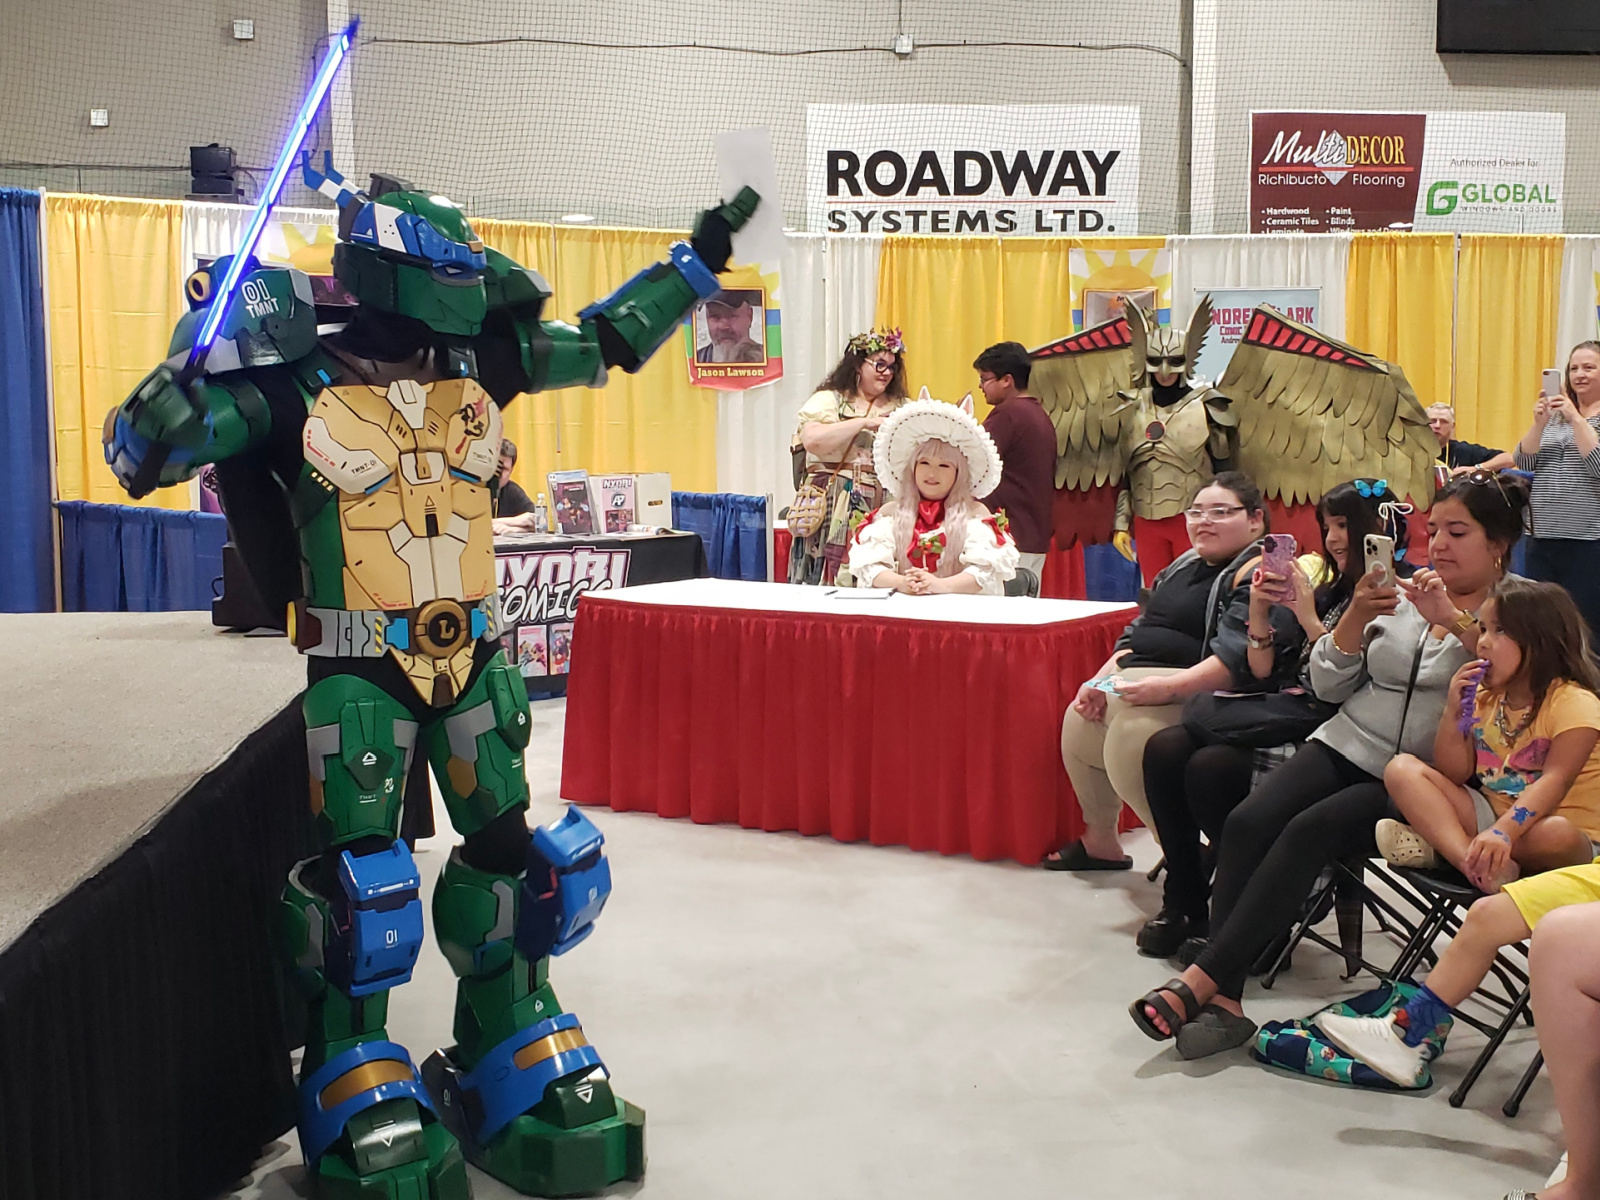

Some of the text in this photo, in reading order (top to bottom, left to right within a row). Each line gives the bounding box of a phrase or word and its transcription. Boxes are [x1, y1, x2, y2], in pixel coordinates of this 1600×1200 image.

[1261, 129, 1406, 165] Multi DECOR
[1451, 158, 1539, 167] Authorized Dealer for
[826, 150, 1121, 197] ROADWAY
[1258, 173, 1406, 188] Richibucto Flooring
[1462, 183, 1557, 204] GLOBAL
[1266, 207, 1310, 215] Hardwood
[1330, 207, 1352, 215] Paint
[827, 210, 1115, 233] SYSTEMS LTD.
[1266, 217, 1320, 225] Ceramic Tiles
[1330, 217, 1355, 225] Blinds
[245, 297, 280, 319] TMNT
[1209, 308, 1256, 326] NDRE
[697, 367, 765, 379] Jason Lawson
